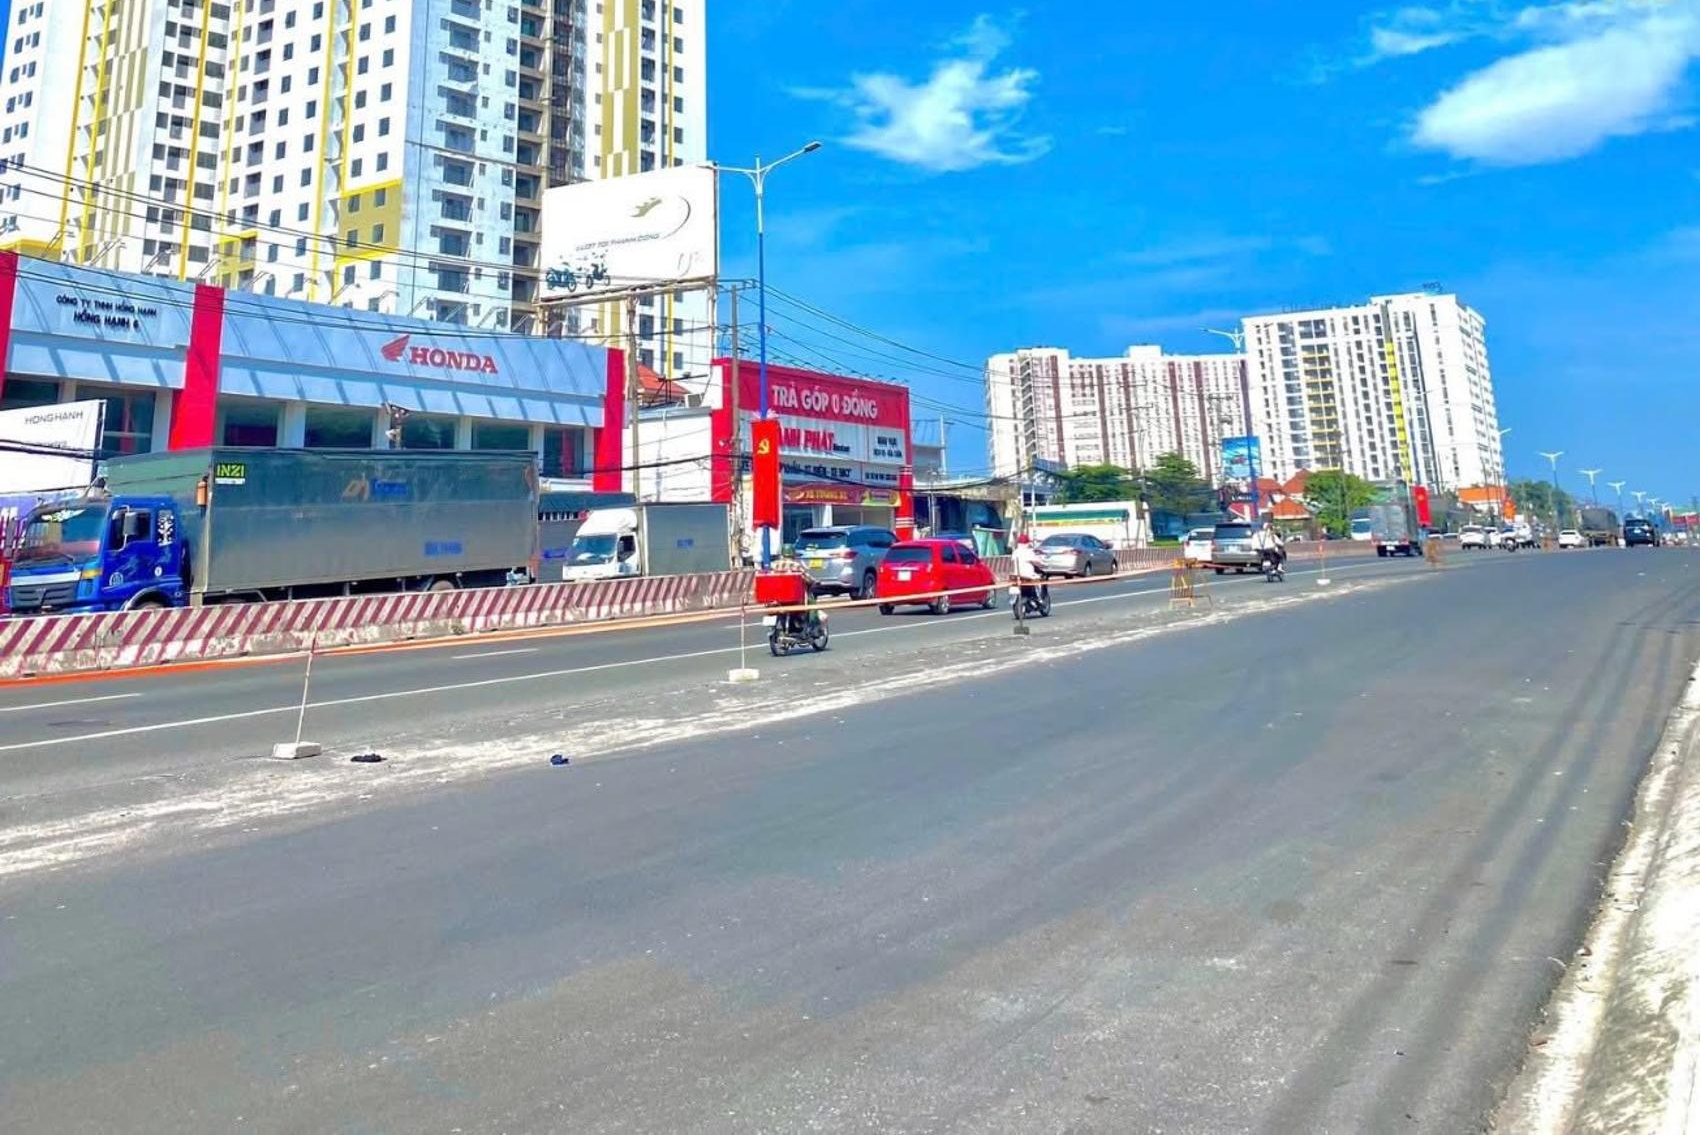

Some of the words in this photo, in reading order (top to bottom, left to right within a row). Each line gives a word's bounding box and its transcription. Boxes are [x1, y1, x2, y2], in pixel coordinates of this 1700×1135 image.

[81, 298, 91, 308] TY
[409, 346, 498, 374] HONDA
[771, 381, 798, 409] TRẢ
[801, 385, 829, 413] GÓP
[841, 388, 878, 420] ĐỒNG
